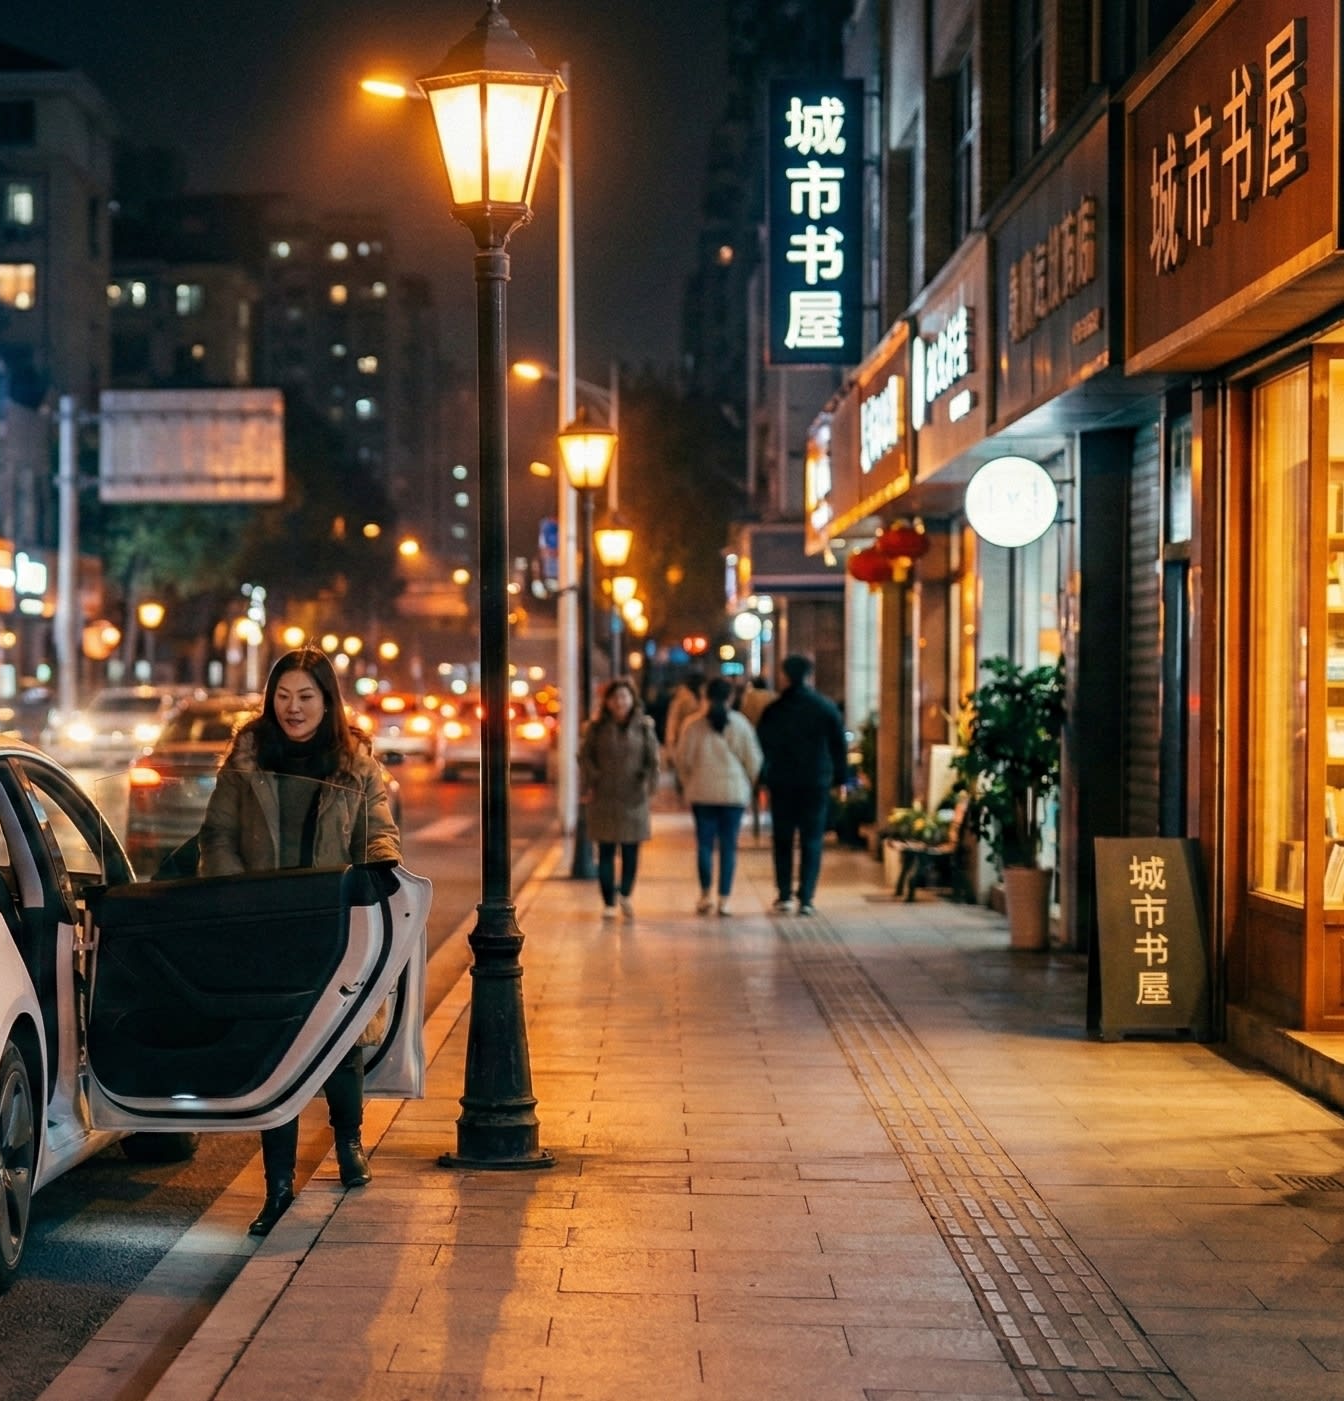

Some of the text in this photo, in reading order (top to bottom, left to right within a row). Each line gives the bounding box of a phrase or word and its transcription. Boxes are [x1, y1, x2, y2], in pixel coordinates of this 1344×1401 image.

[784, 96, 846, 349] 城市书屋
[1150, 18, 1296, 276] 城市书屋
[1129, 855, 1172, 1005] 城市书屋
